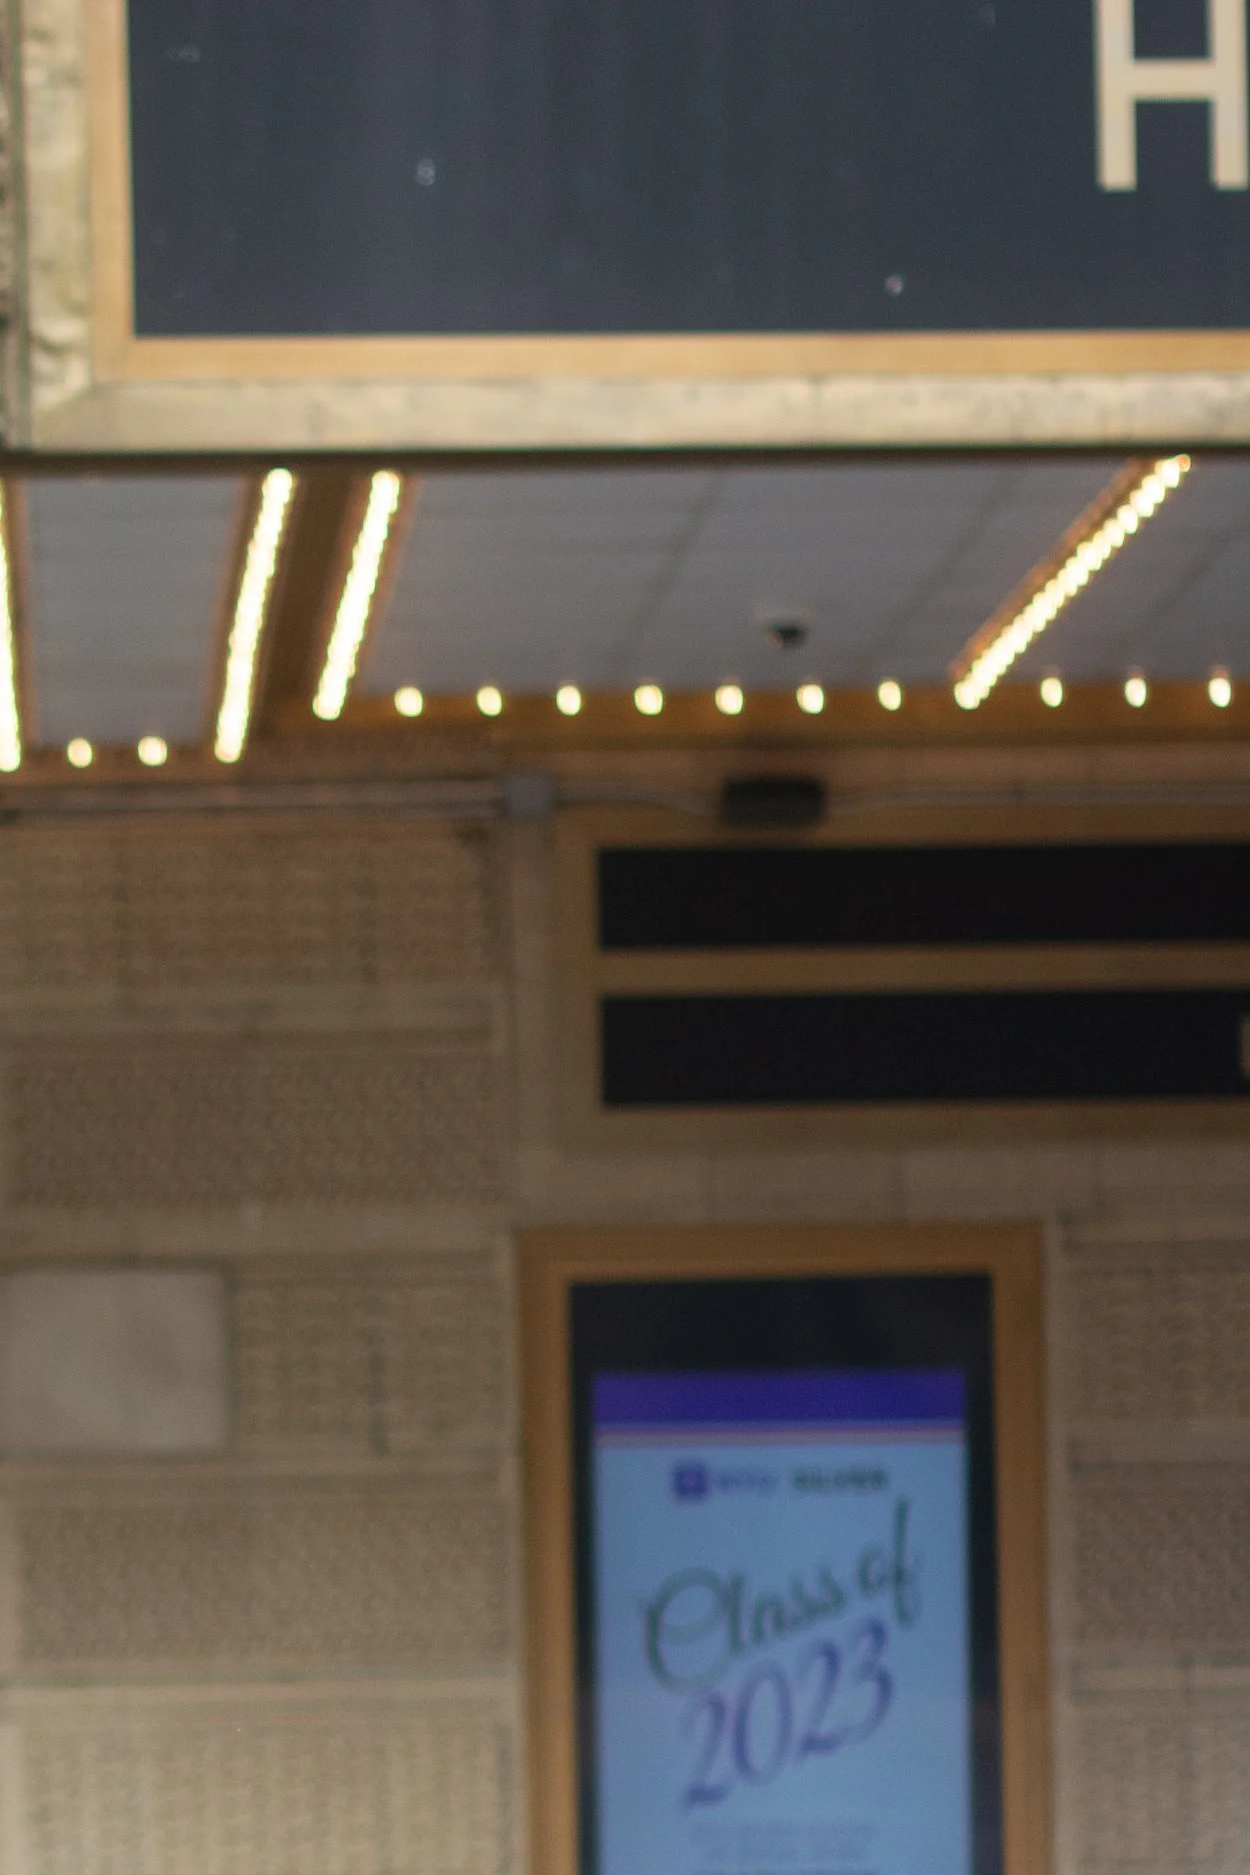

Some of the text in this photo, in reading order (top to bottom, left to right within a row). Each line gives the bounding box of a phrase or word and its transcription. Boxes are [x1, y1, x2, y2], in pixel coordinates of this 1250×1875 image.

[1095, 0, 1249, 191] H
[643, 1494, 922, 1692] Class of
[679, 1614, 893, 1814] 2023
